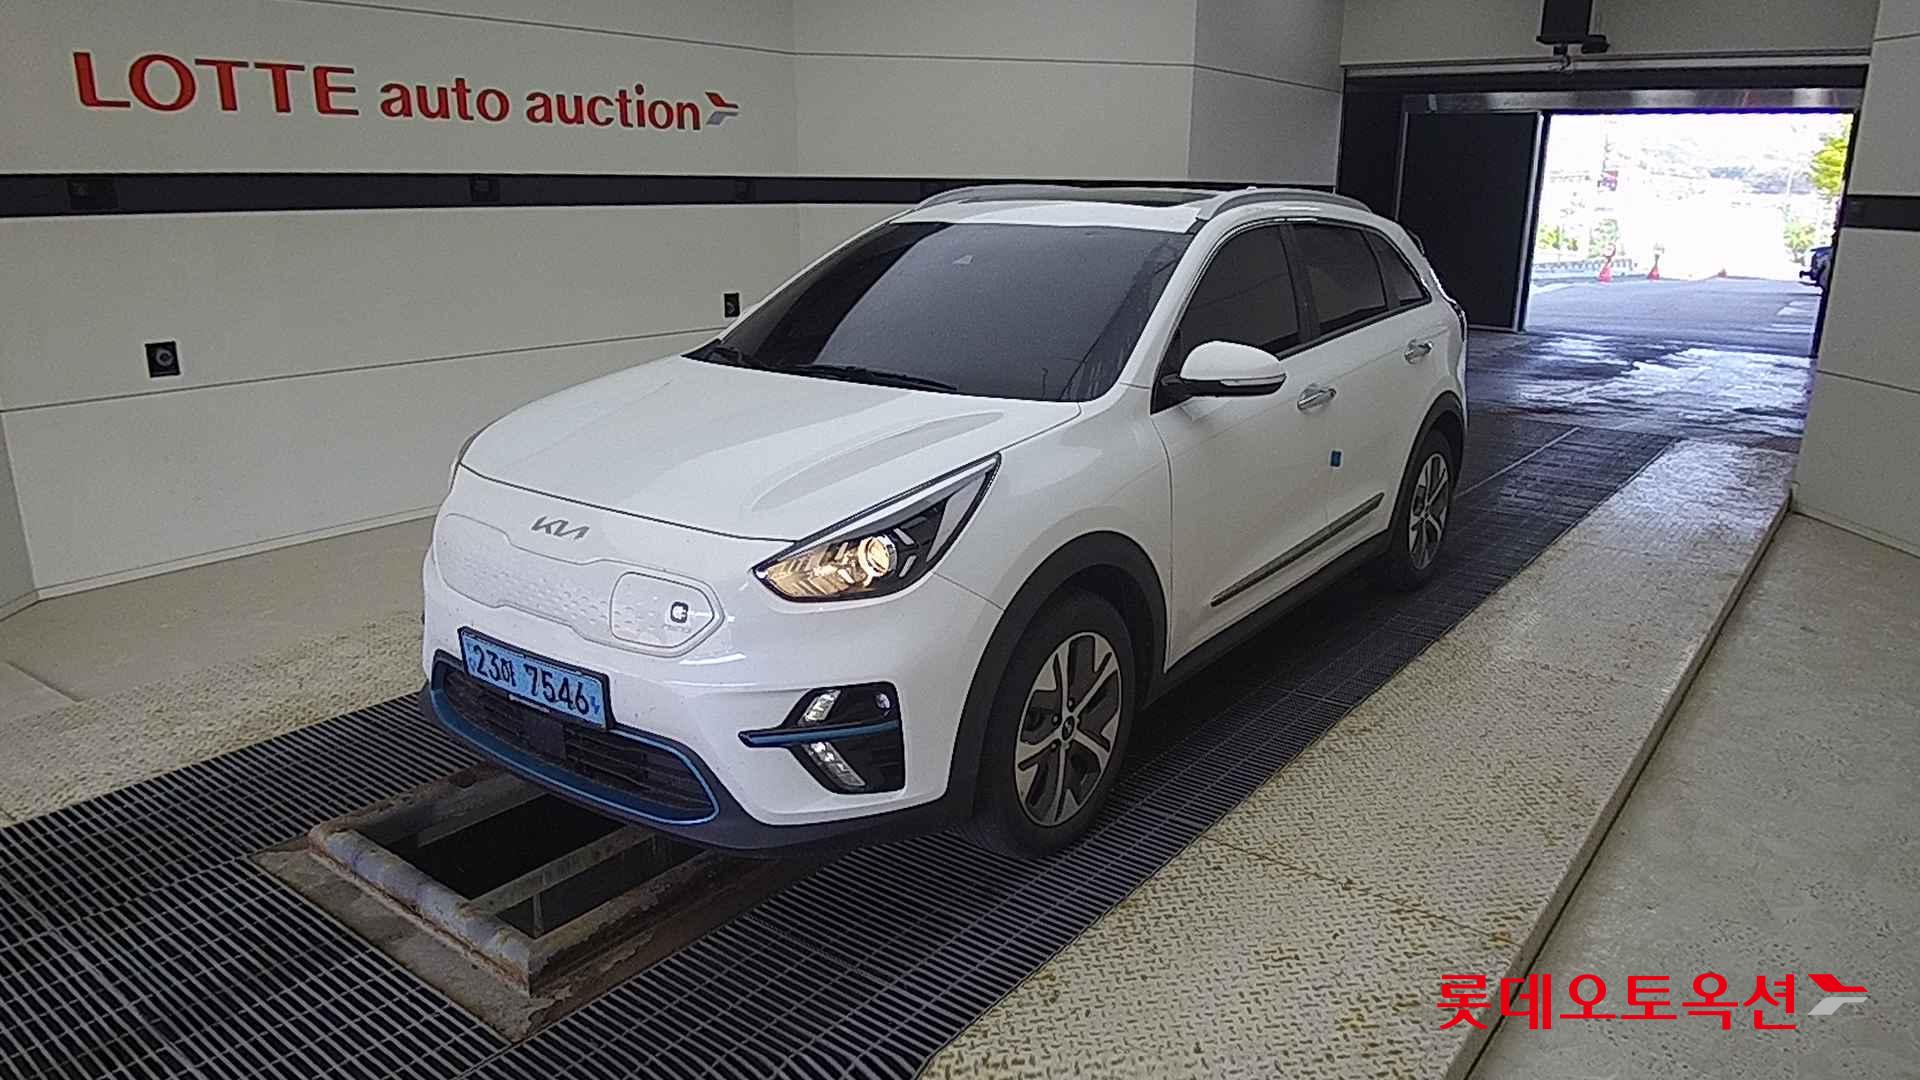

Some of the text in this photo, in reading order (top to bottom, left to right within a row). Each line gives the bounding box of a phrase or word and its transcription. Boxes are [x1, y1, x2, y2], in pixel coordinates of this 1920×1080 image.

[73, 51, 701, 130] LOTTE auto auction
[523, 663, 590, 715] 7546
